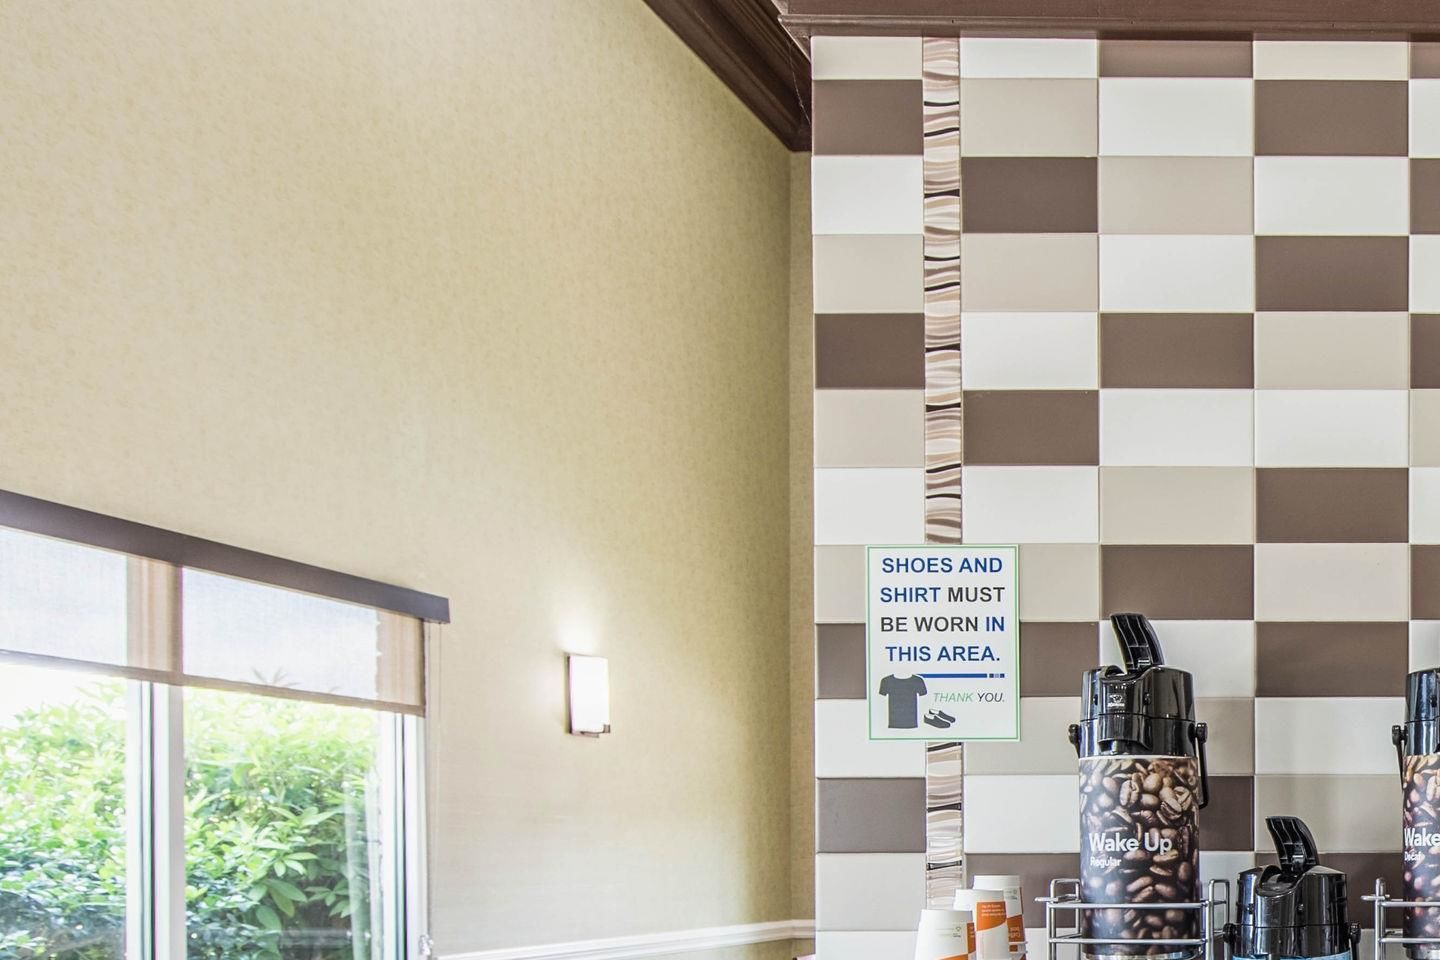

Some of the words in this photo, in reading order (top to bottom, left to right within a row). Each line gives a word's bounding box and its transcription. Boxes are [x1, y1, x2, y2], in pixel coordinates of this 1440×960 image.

[881, 557, 953, 573] SHOES
[959, 557, 1003, 573] AND
[880, 587, 941, 603] SHIRT
[948, 587, 1005, 602] MUST
[880, 617, 908, 632] BE
[914, 616, 978, 632] WORN
[985, 616, 1005, 632] IN
[885, 646, 931, 662] THIS
[937, 646, 1001, 662] AREA.
[933, 692, 974, 703] THANK
[977, 692, 1005, 703] YOU.
[1088, 832, 1139, 852] Wake
[1144, 832, 1173, 856] Up
[1090, 856, 1122, 869] Regular
